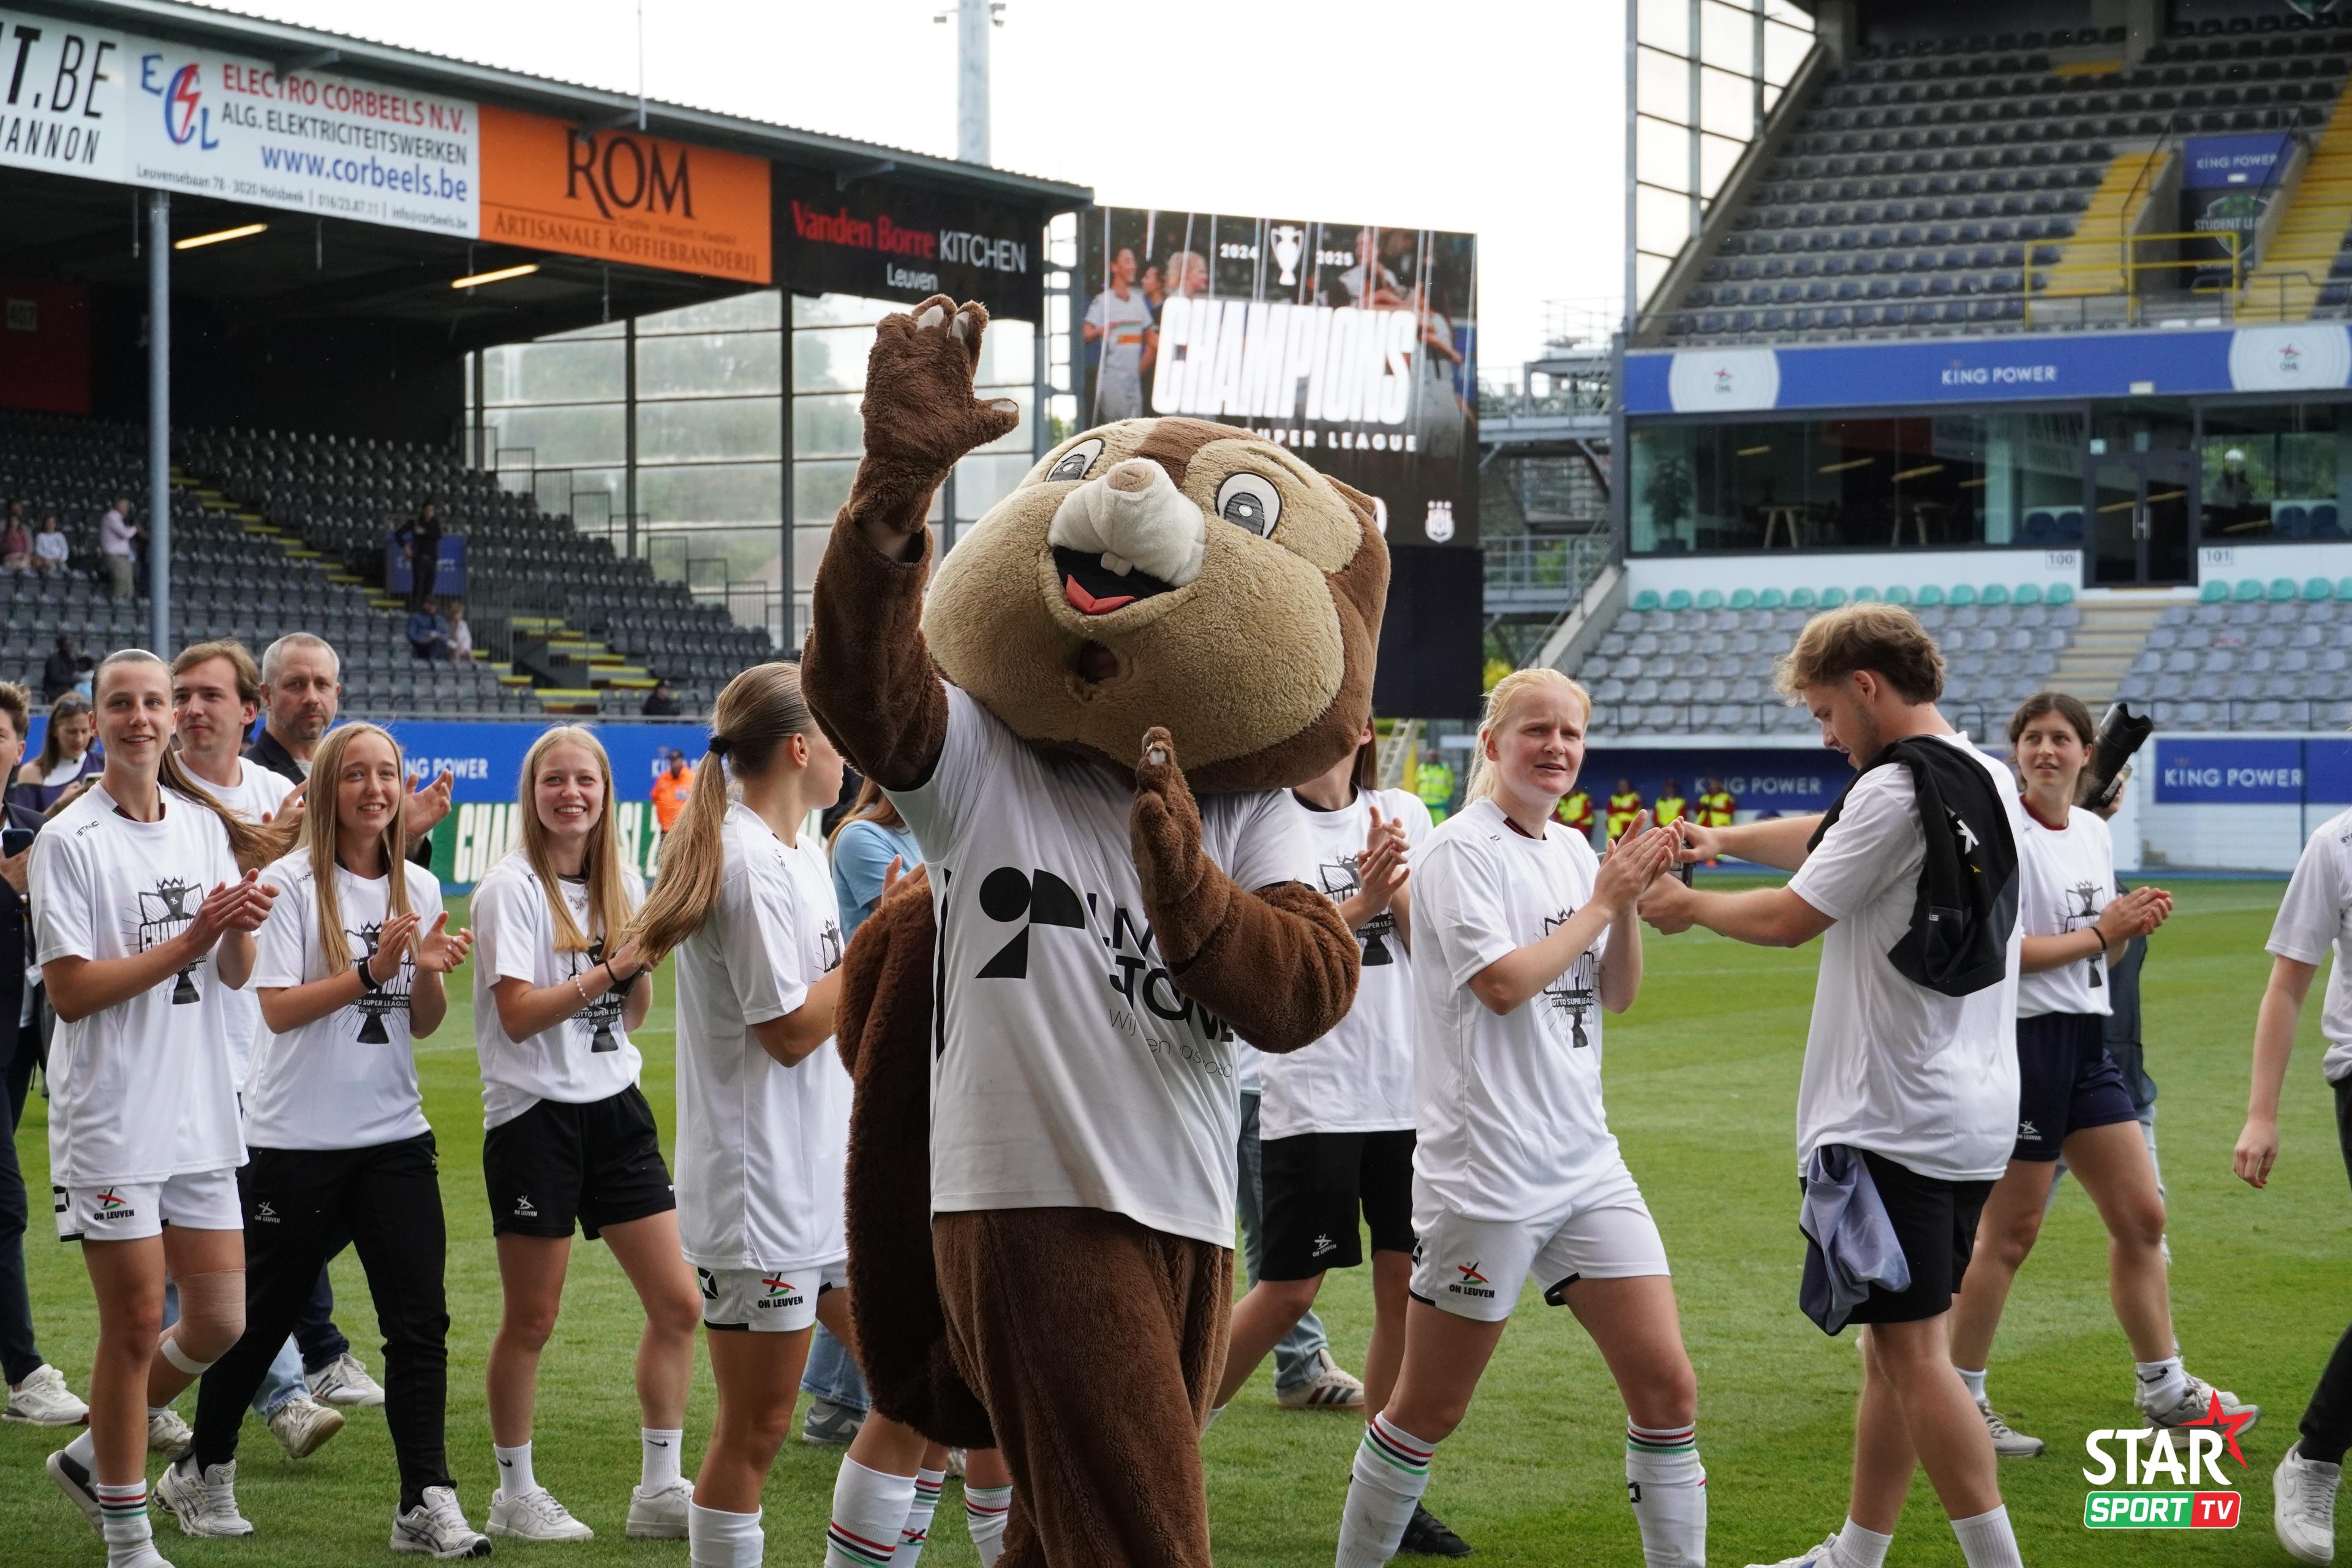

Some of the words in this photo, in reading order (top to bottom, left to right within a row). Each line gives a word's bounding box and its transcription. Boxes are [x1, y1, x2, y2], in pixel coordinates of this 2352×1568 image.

[0, 22, 116, 119] T.BE
[224, 63, 317, 106] ELECTRO
[323, 83, 424, 127] CORBEELS
[429, 104, 468, 135] N.V.
[0, 115, 100, 164] ANNON
[221, 102, 262, 129] ALG.
[266, 109, 467, 166] ELEKTRICITEITSWERKEN
[2196, 156, 2230, 170] KING
[2233, 153, 2277, 167] POWER
[137, 164, 209, 187] Leuvensebaan
[261, 145, 468, 202] www.corbeels.be
[564, 127, 696, 220] ROM
[494, 211, 602, 250] ARTISANALE
[609, 225, 758, 277] KOFFIEBRANDERIJ
[791, 199, 872, 248] Vanden
[877, 214, 936, 259] Borre
[939, 229, 1027, 274] KITCHEN
[1220, 243, 1260, 260] 2024
[1316, 250, 1354, 266] 2025
[886, 262, 939, 292] Leuven
[1152, 296, 1418, 425] CHAMPIONS
[1941, 367, 1988, 386] KING
[1992, 365, 2057, 383] POWER
[1327, 431, 1417, 453] LEAGUE
[2049, 552, 2073, 565] 100
[2206, 549, 2230, 562] 101
[432, 757, 489, 780] POWER
[2164, 767, 2221, 788] KING
[2226, 767, 2304, 788] POWER
[1751, 776, 1822, 795] POWER
[94, 1212, 105, 1221] OH
[107, 1209, 135, 1219] LEUVEN
[1320, 1243, 1337, 1254] LEUVEN
[758, 1299, 771, 1308] OH
[773, 1295, 804, 1308] LEUVEN
[1449, 1284, 1461, 1294] OH
[1463, 1286, 1495, 1298] LEUVEN
